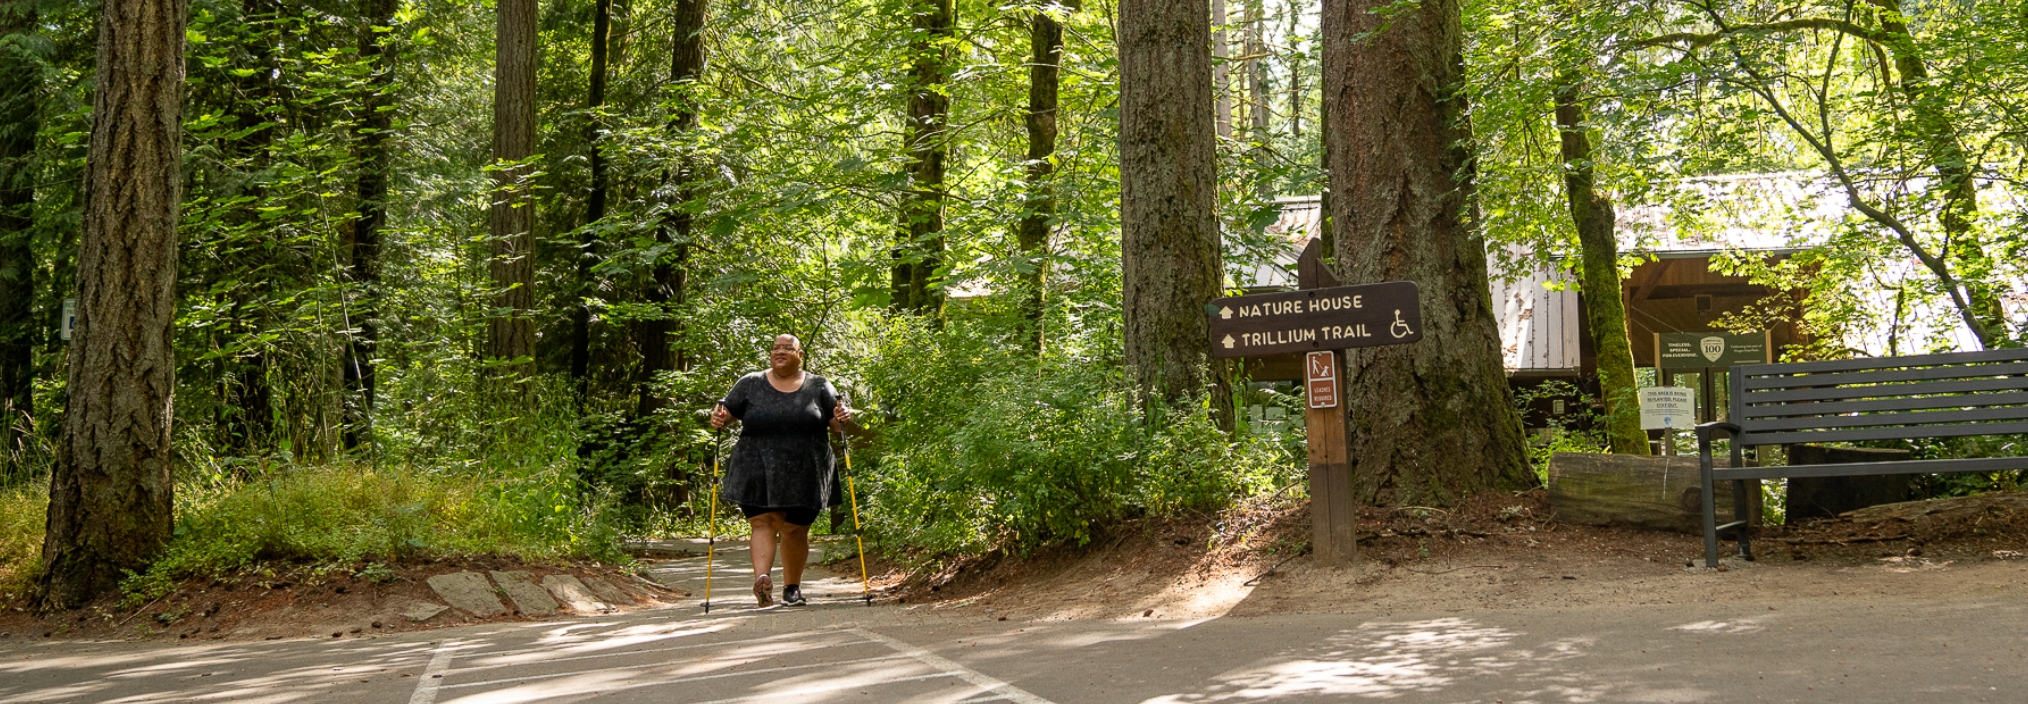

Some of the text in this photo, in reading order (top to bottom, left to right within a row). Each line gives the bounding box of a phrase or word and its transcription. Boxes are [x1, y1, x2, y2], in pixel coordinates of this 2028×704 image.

[1239, 295, 1363, 318] NATURE HOUSE
[1241, 323, 1372, 347] TRILLIUM TRAIL
[1705, 345, 1721, 353] 100
